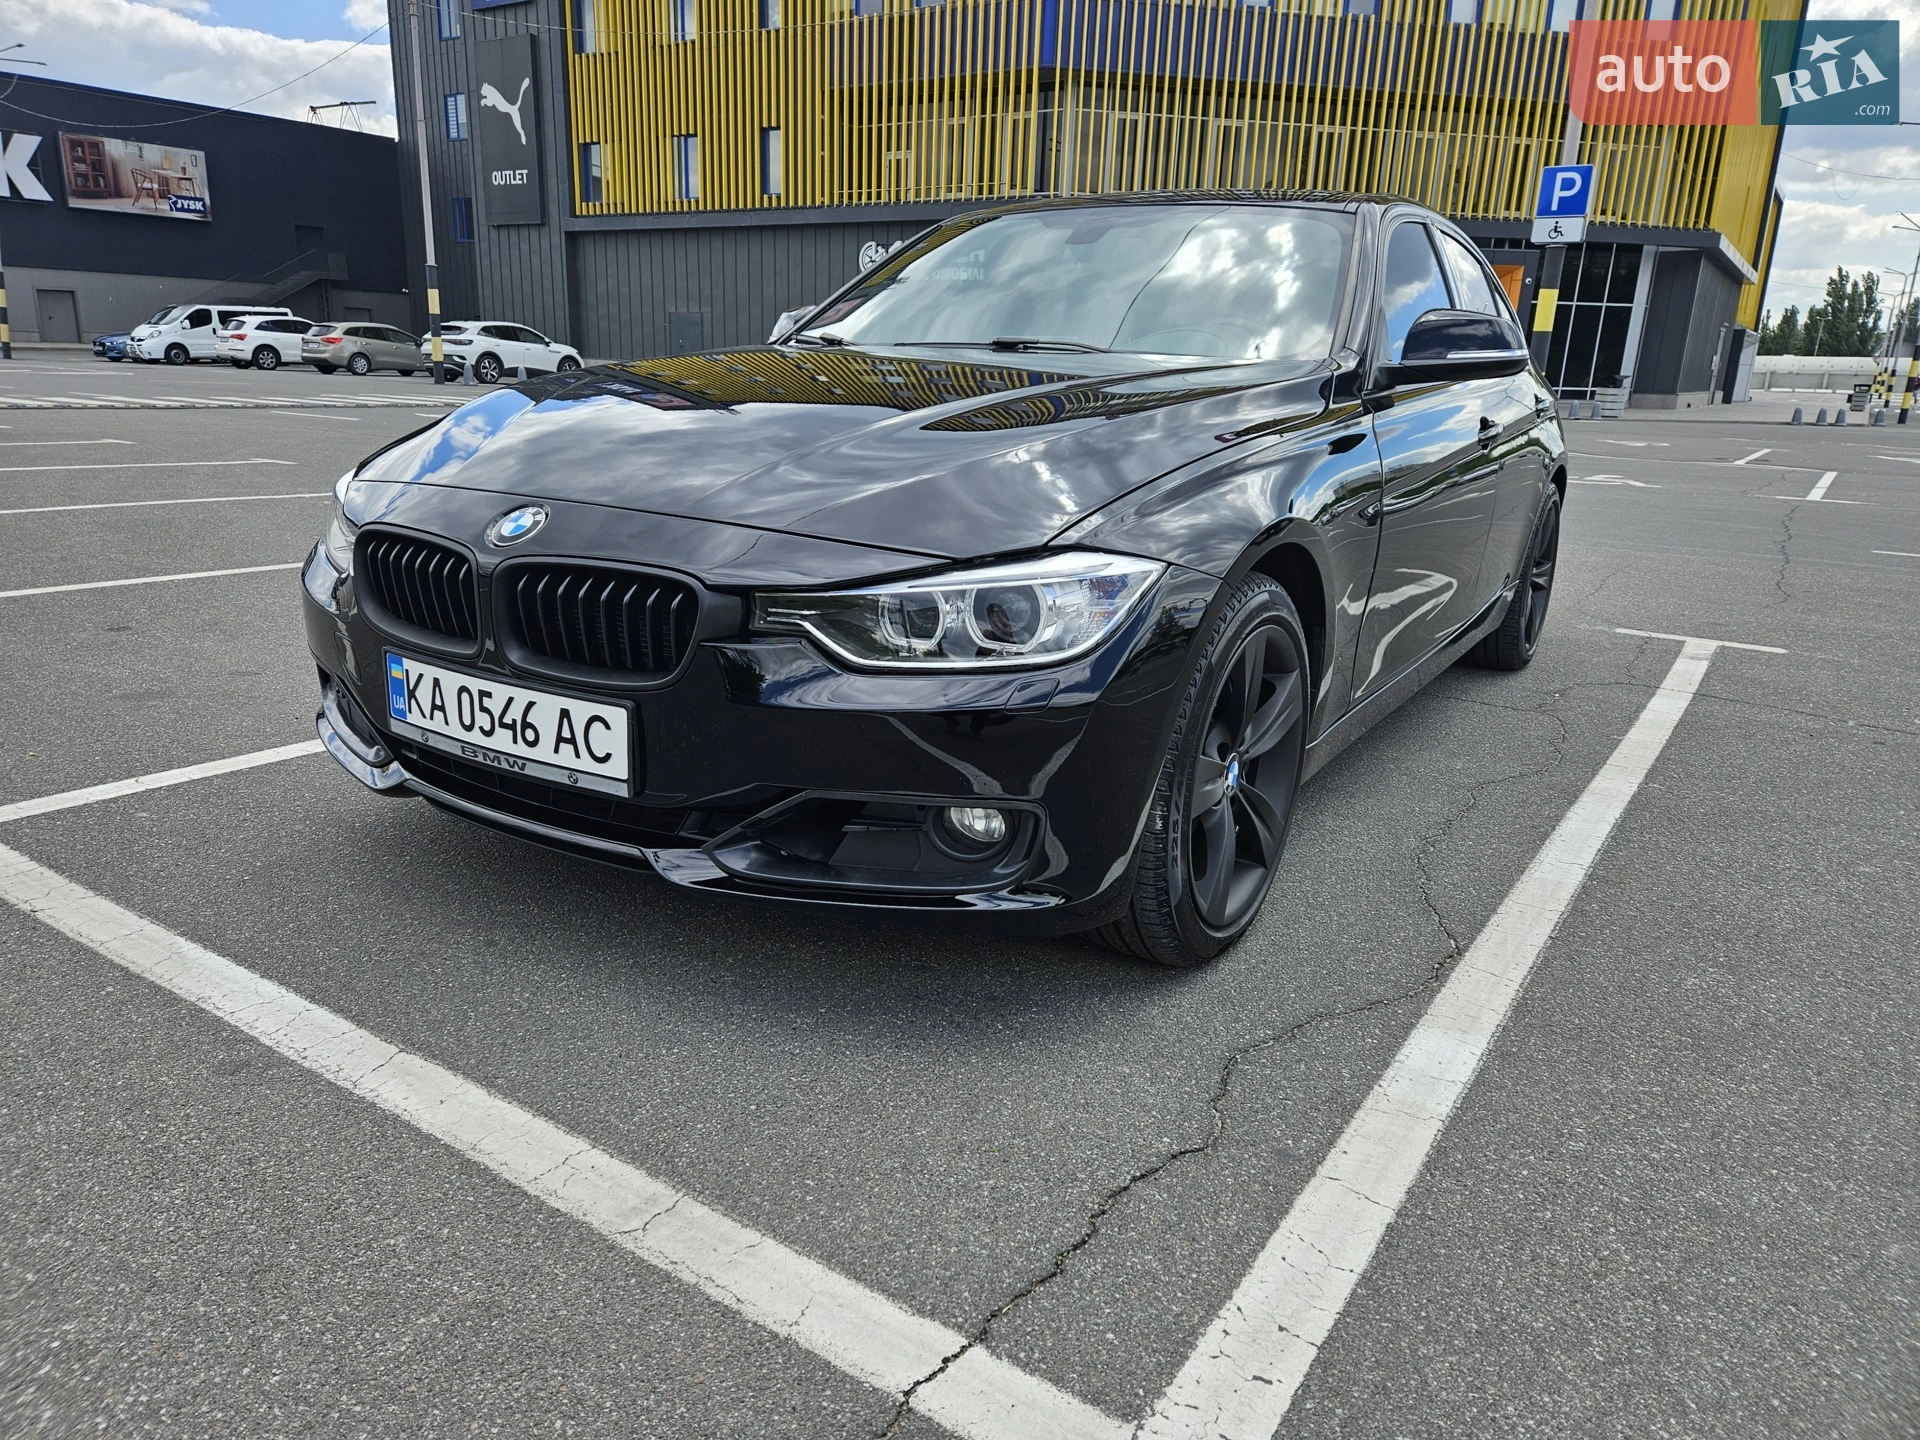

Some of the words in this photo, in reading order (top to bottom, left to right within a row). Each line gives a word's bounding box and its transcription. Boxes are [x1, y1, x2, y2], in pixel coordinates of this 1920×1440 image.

[492, 169, 528, 185] OUTLET
[1551, 171, 1582, 211] P
[176, 199, 205, 211] JYSK
[393, 694, 406, 712] UA
[405, 668, 450, 726] KA
[457, 684, 540, 748] 0546
[553, 707, 612, 764] AC
[460, 744, 527, 772] BMW
